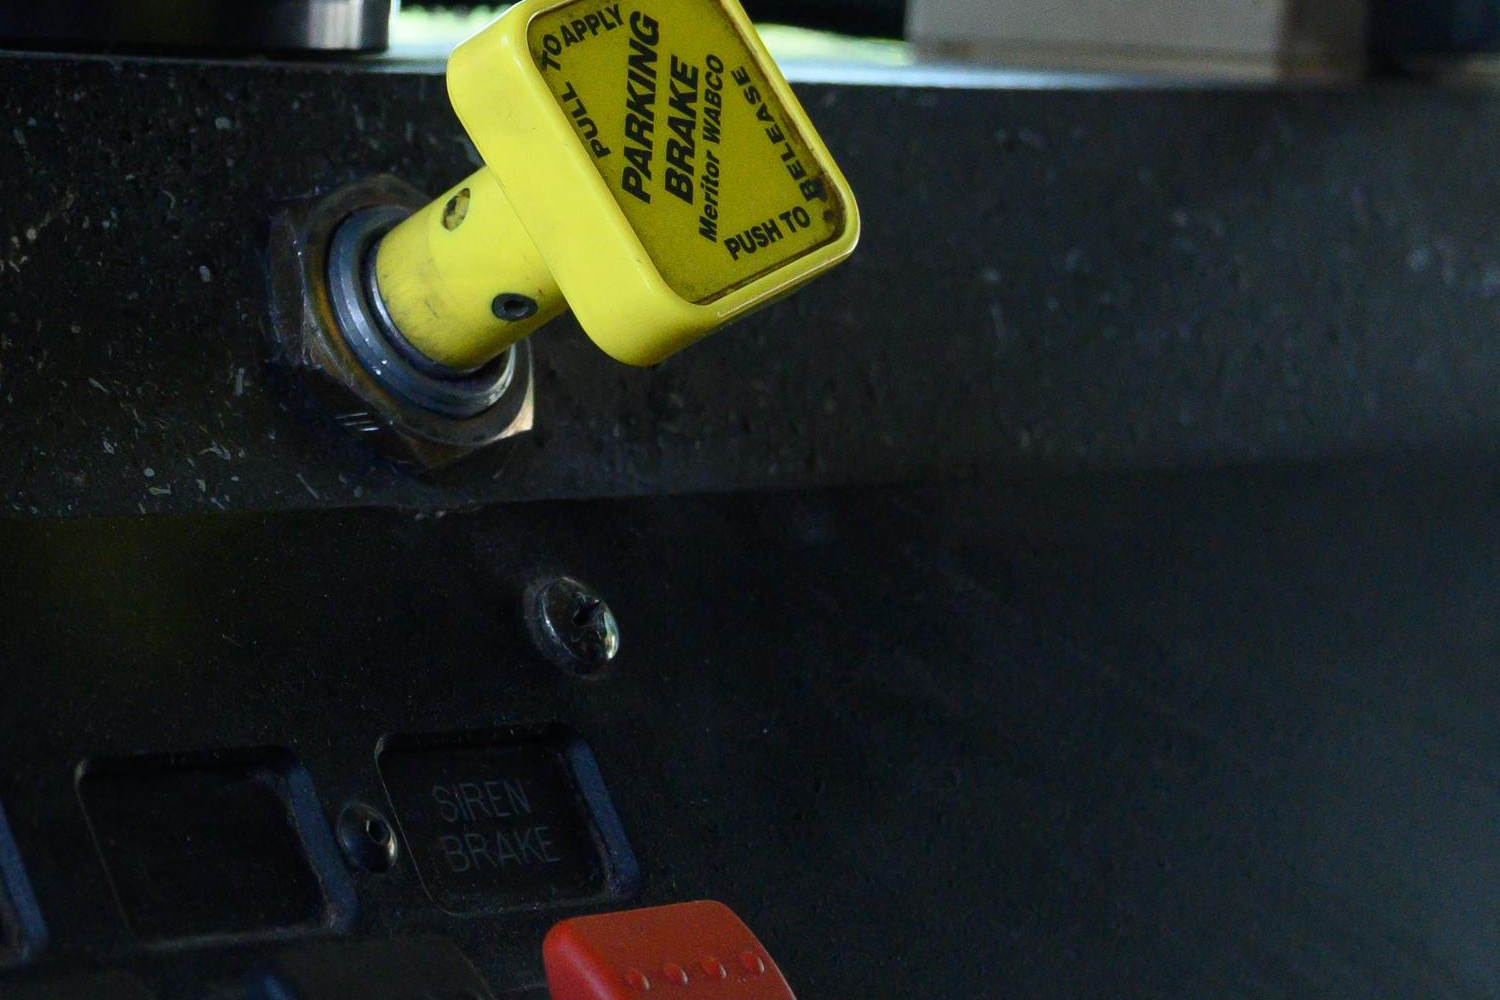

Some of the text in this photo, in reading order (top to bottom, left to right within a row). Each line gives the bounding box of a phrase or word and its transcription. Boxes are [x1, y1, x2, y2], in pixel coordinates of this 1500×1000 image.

[540, 3, 624, 160] PULL TO APPLY
[621, 10, 660, 204] PARKING
[664, 55, 698, 205] BRAKE
[698, 53, 725, 243] Meritor WABCO
[723, 66, 826, 261] PUSH TO RELEASE
[431, 778, 532, 824] SIREN
[439, 825, 561, 874] BRAKE
